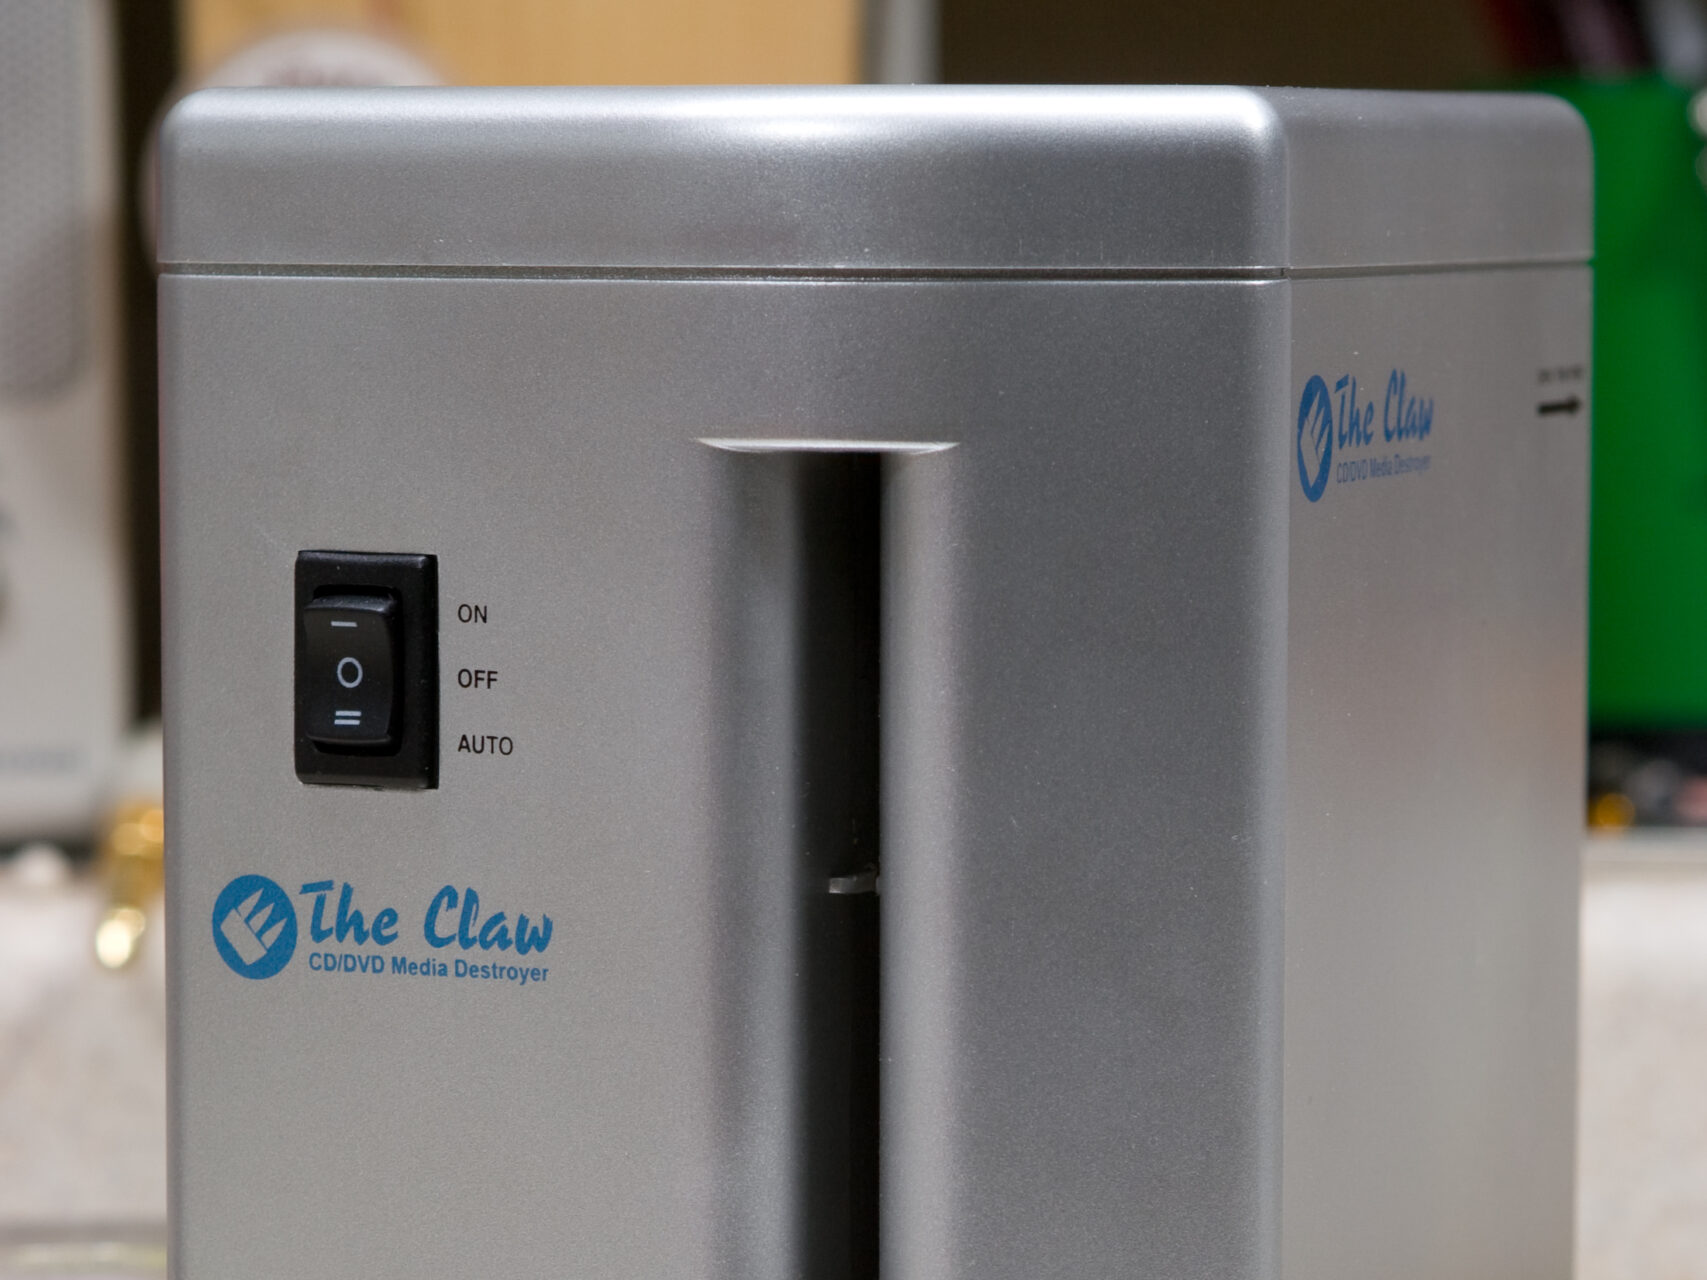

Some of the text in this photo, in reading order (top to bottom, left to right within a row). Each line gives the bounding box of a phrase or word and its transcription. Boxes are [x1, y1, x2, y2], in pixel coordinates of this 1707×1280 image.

[1334, 367, 1434, 450] The Claw
[457, 603, 488, 624] ON
[457, 668, 499, 689] OFF
[457, 734, 514, 756] AUTO
[299, 879, 554, 956] The Claw
[308, 951, 551, 986] CD/DVD Media Destroyer
